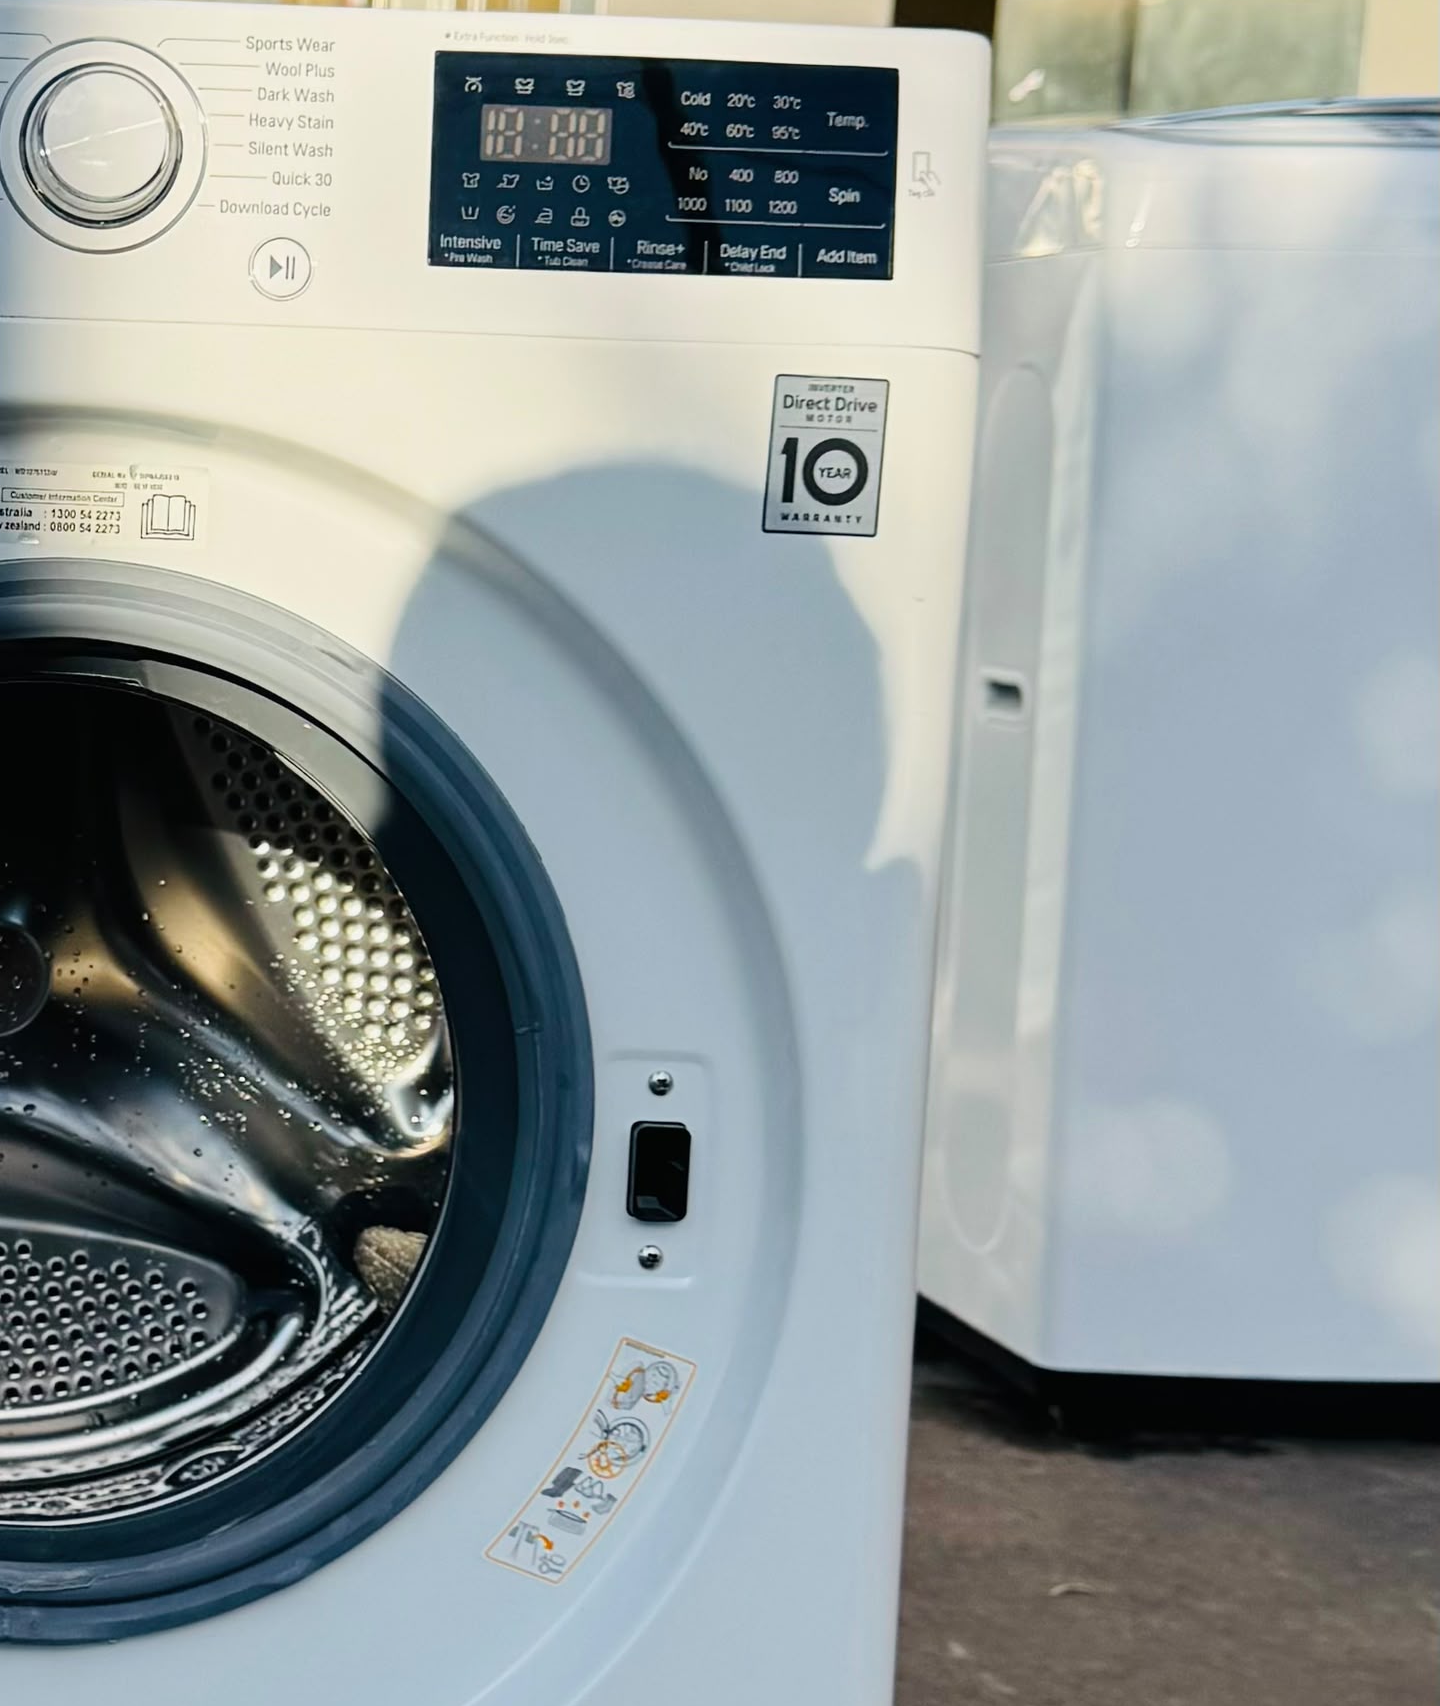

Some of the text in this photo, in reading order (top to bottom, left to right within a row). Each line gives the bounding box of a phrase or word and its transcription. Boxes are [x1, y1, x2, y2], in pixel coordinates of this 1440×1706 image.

[246, 36, 335, 54] Sports Wear
[266, 63, 335, 79] Wool Plus
[258, 87, 335, 104] Dark Wash
[681, 91, 711, 106] Cold
[249, 113, 334, 132] Heavy Stain
[827, 111, 869, 130] Temp.
[249, 141, 333, 159] Silent Wash
[272, 171, 332, 187] Quick 30
[689, 167, 799, 184] No 400 800
[829, 187, 860, 205] Spin
[220, 201, 331, 219] Download Cycle
[678, 197, 797, 214] 1000 1100 1200
[440, 234, 501, 250] Intensive
[532, 237, 600, 253] Time Save
[720, 244, 786, 260] Delay End
[816, 249, 877, 264] Add Item
[783, 394, 878, 413] Direct Drive
[806, 414, 852, 423] MOTOR
[781, 437, 868, 506] 10
[819, 467, 852, 479] YEAR
[49, 493, 91, 502] Information
[51, 509, 76, 519] 1300
[80, 510, 92, 520] 54
[95, 510, 121, 521] 2273
[781, 513, 862, 523] WARRANTY
[4, 521, 40, 532] zealand
[50, 522, 76, 532] 0800
[79, 523, 91, 533] 54
[95, 523, 120, 534] 2273
